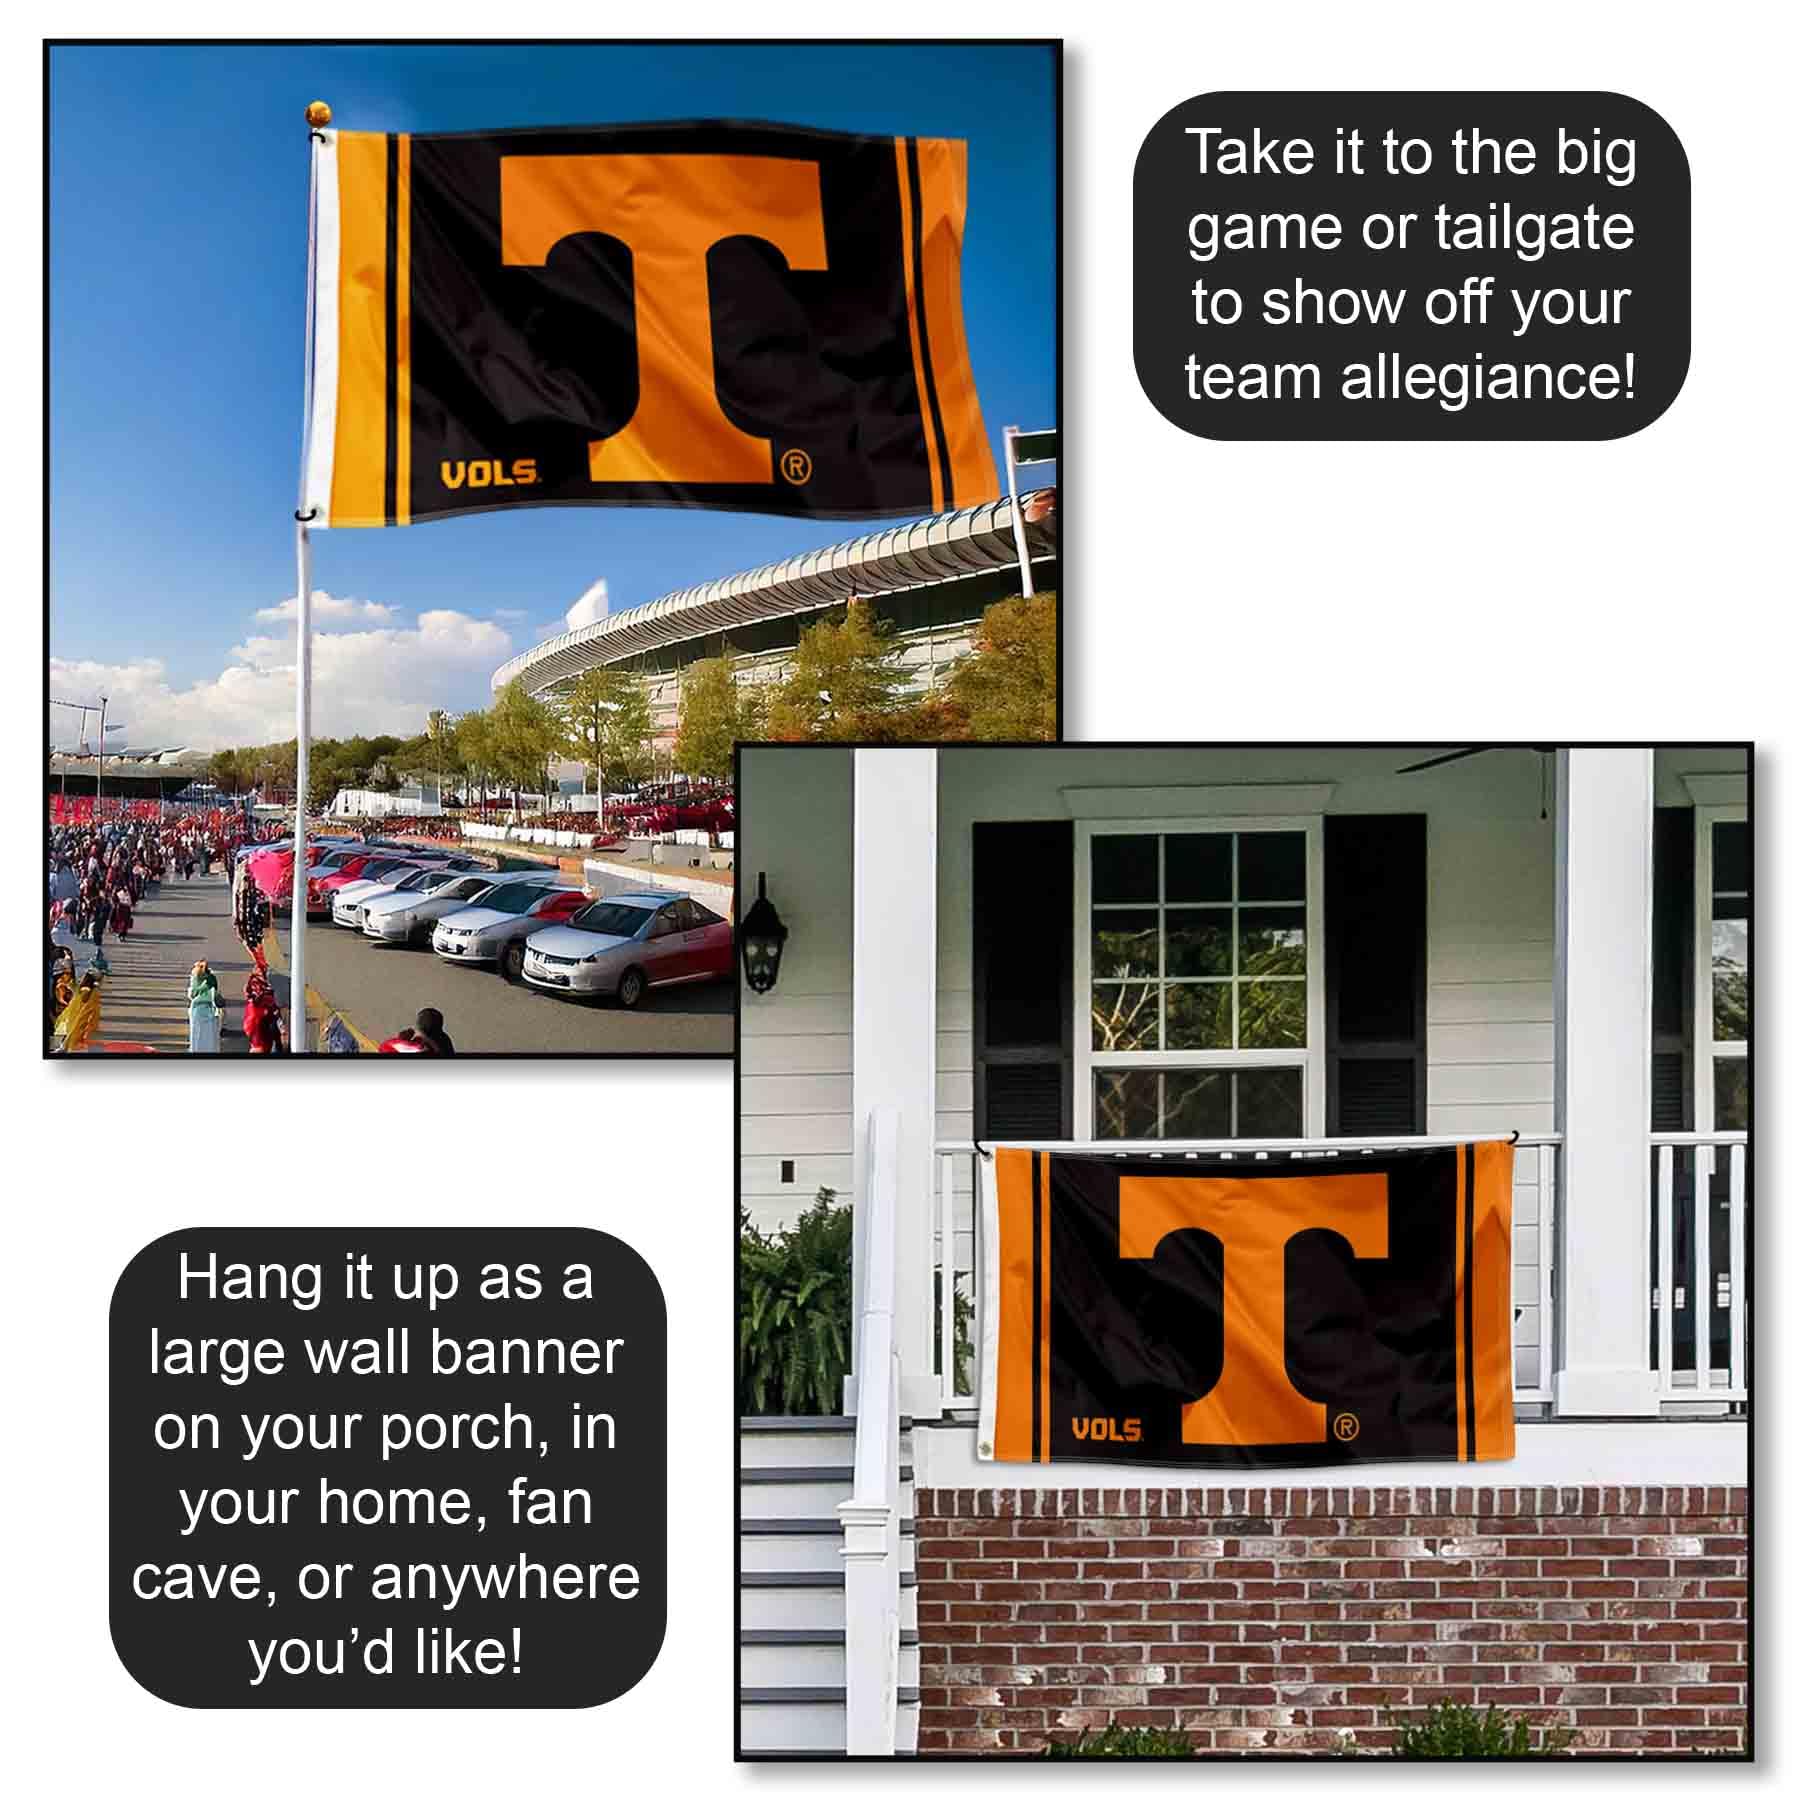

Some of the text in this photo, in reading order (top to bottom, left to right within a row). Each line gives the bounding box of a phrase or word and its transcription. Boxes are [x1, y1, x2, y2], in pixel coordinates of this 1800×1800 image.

[500, 153, 829, 484] T
[440, 459, 538, 489] VOLS
[1118, 1173, 1389, 1446] T
[1071, 1417, 1142, 1442] VOLS
